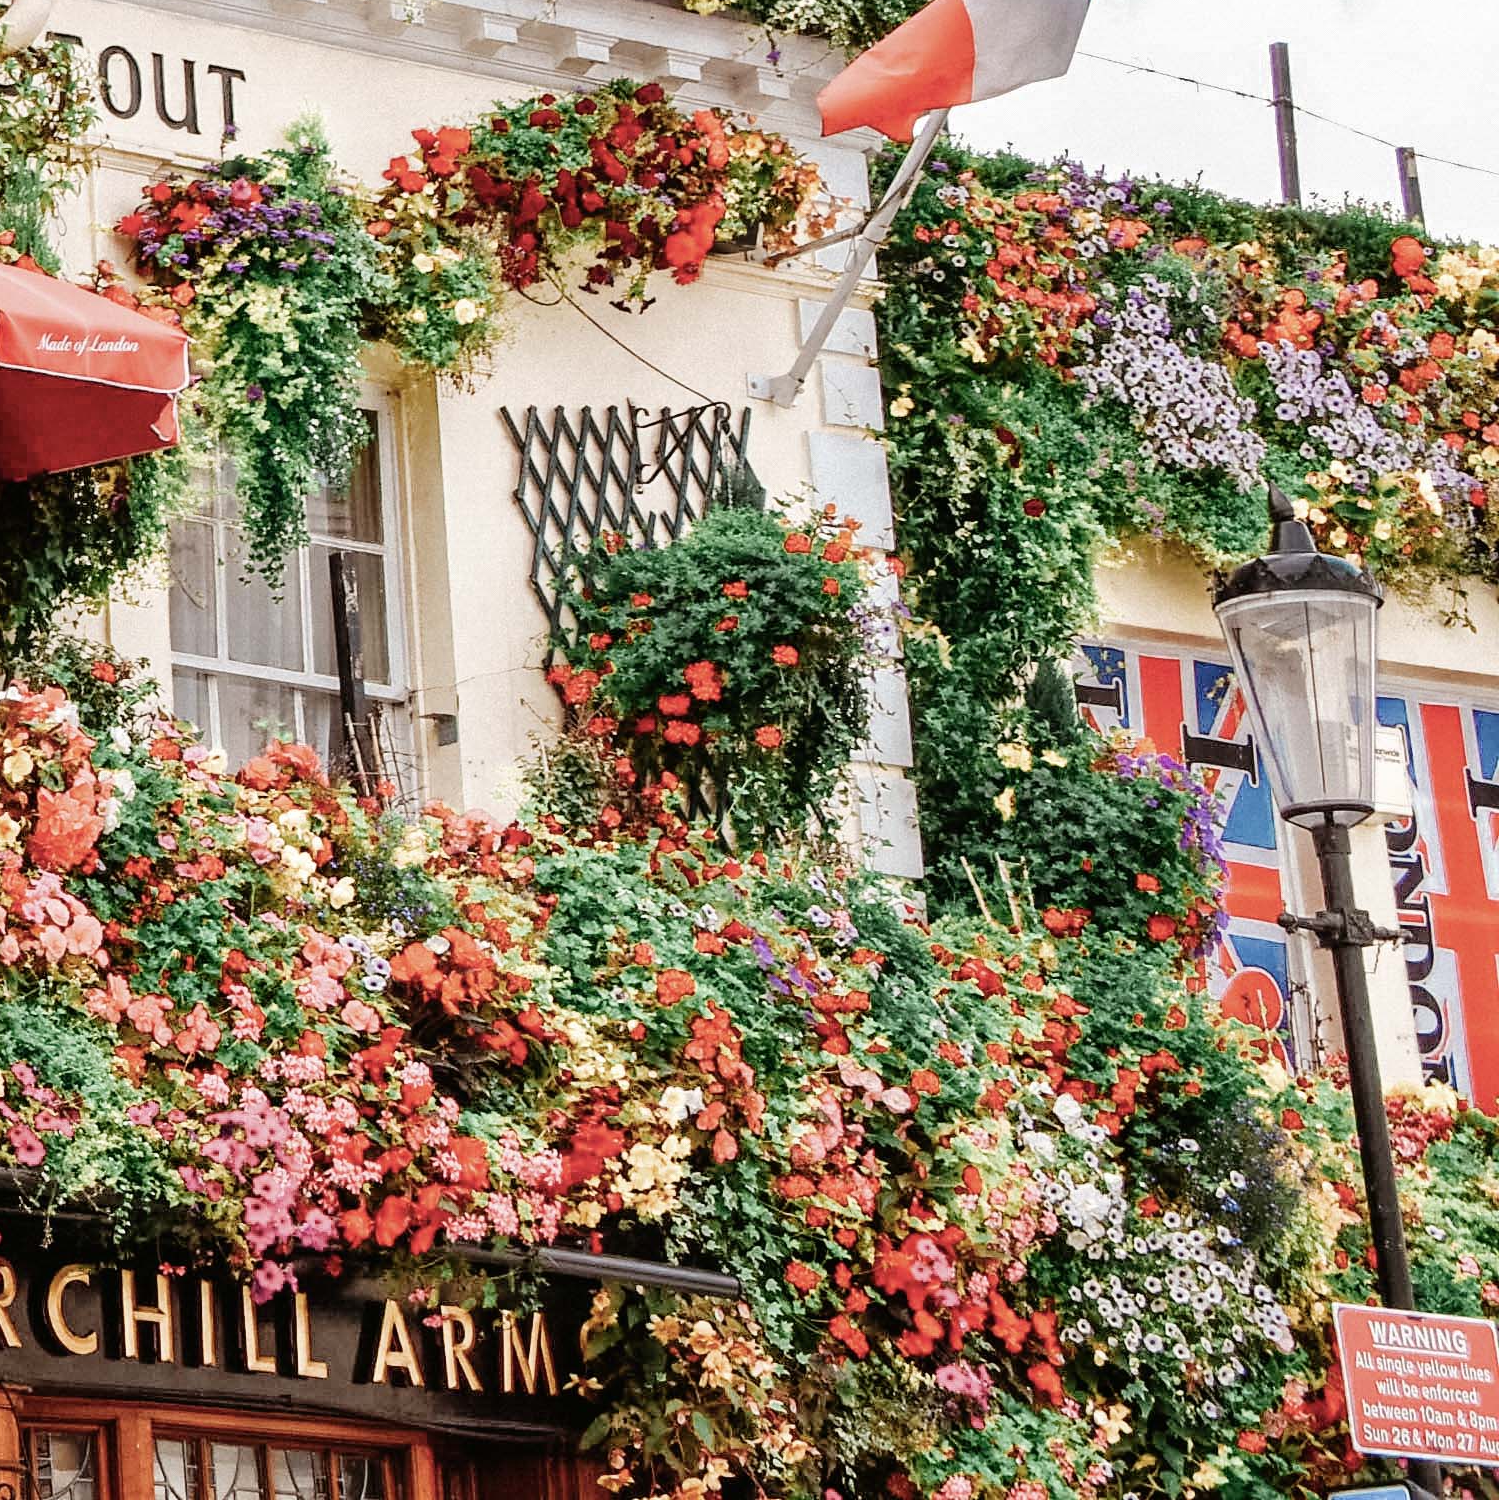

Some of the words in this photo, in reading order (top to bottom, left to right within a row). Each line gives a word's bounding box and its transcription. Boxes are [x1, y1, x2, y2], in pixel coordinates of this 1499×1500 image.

[36, 332, 73, 352] Made
[73, 333, 91, 357] of
[87, 333, 140, 353] London
[372, 1297, 609, 1398] ARM
[1368, 1320, 1467, 1353] WARNING
[1355, 1351, 1374, 1370] All
[1377, 1354, 1414, 1377] single
[1417, 1359, 1458, 1381] yellow
[1461, 1364, 1491, 1382] lines
[1376, 1378, 1399, 1397] will
[1403, 1379, 1419, 1398] be
[1422, 1383, 1478, 1405] enforced
[1362, 1399, 1418, 1423] between
[1421, 1407, 1454, 1426] 10am
[1457, 1409, 1468, 1427] &
[1469, 1411, 1498, 1432] 8pm
[1363, 1423, 1389, 1443] Sun
[1392, 1426, 1411, 1445] 26
[1412, 1429, 1423, 1446] &
[1425, 1429, 1454, 1449] Mon
[1457, 1433, 1473, 1451] 27
